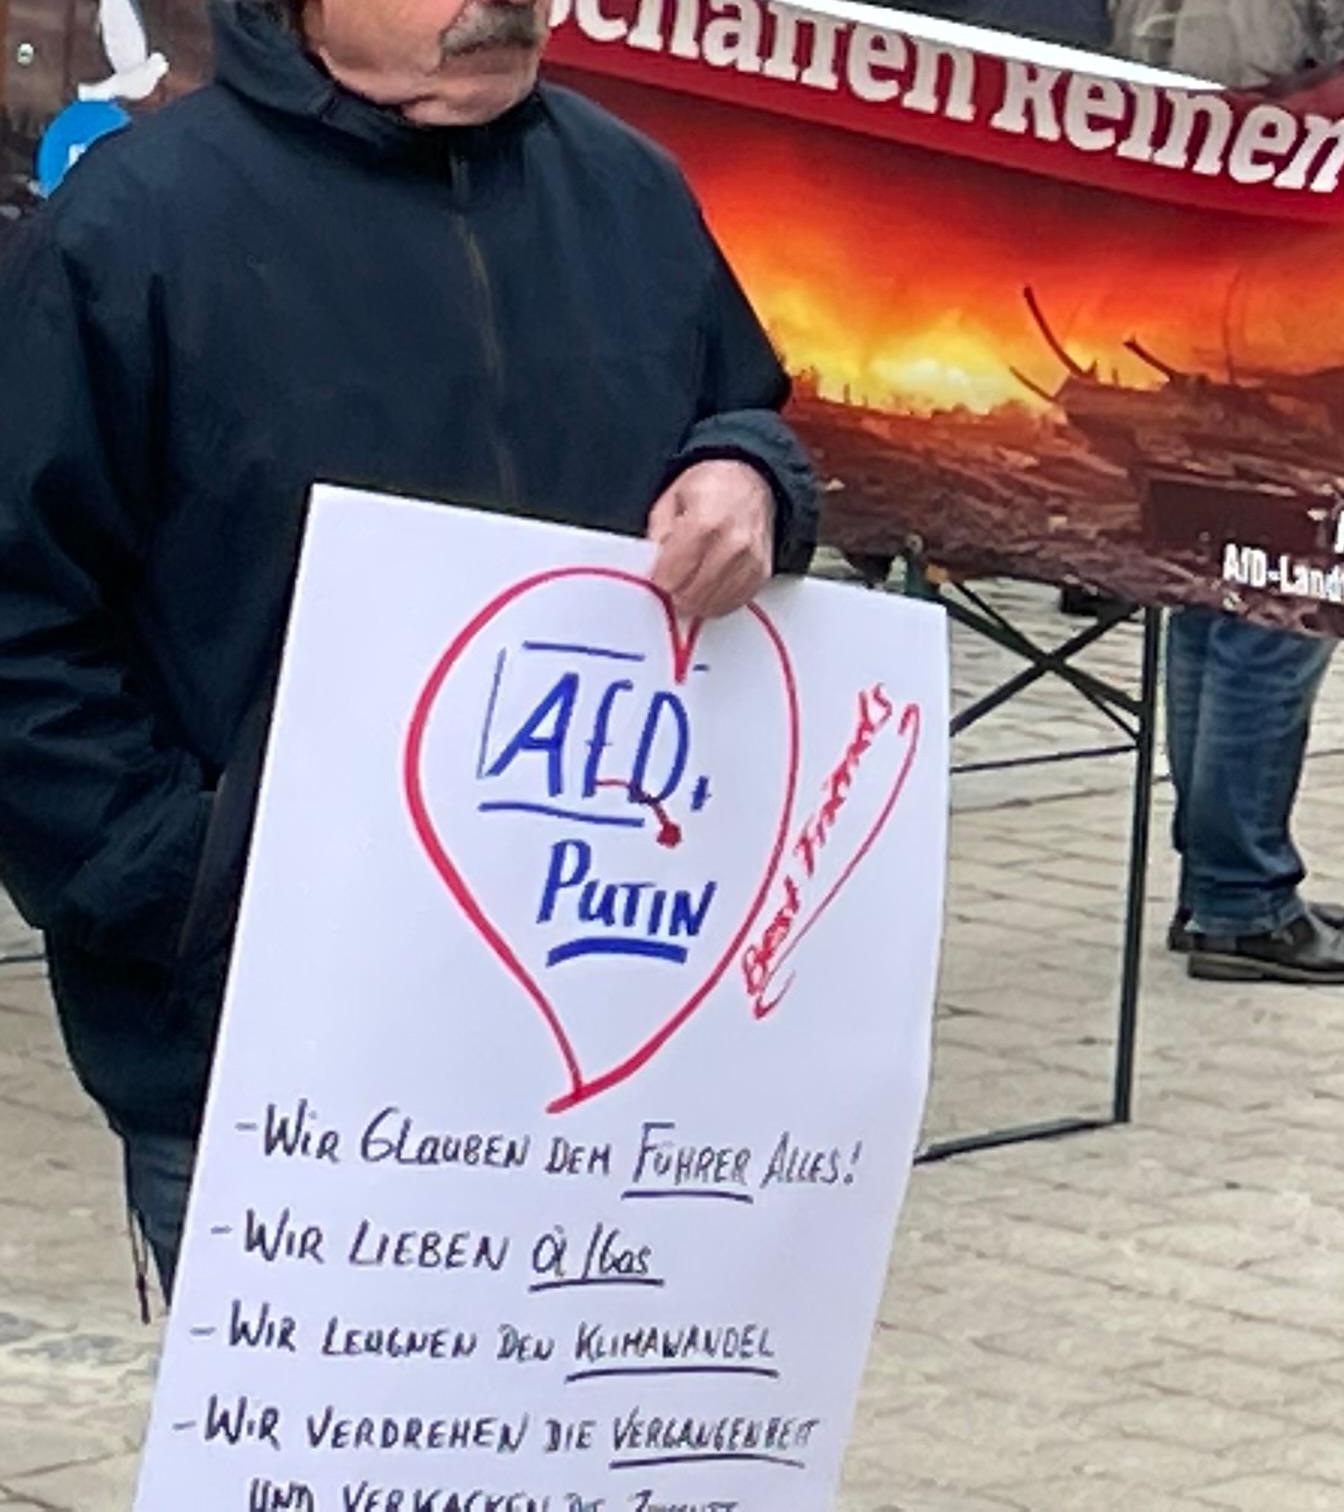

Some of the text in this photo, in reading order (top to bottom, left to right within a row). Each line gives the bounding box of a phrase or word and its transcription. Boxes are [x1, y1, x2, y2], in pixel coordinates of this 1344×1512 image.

[544, 1135, 612, 1176] DEM
[348, 1217, 510, 1271] LIEBEN
[305, 1404, 531, 1455] VERDREHEN
[544, 1418, 598, 1455] DIE
